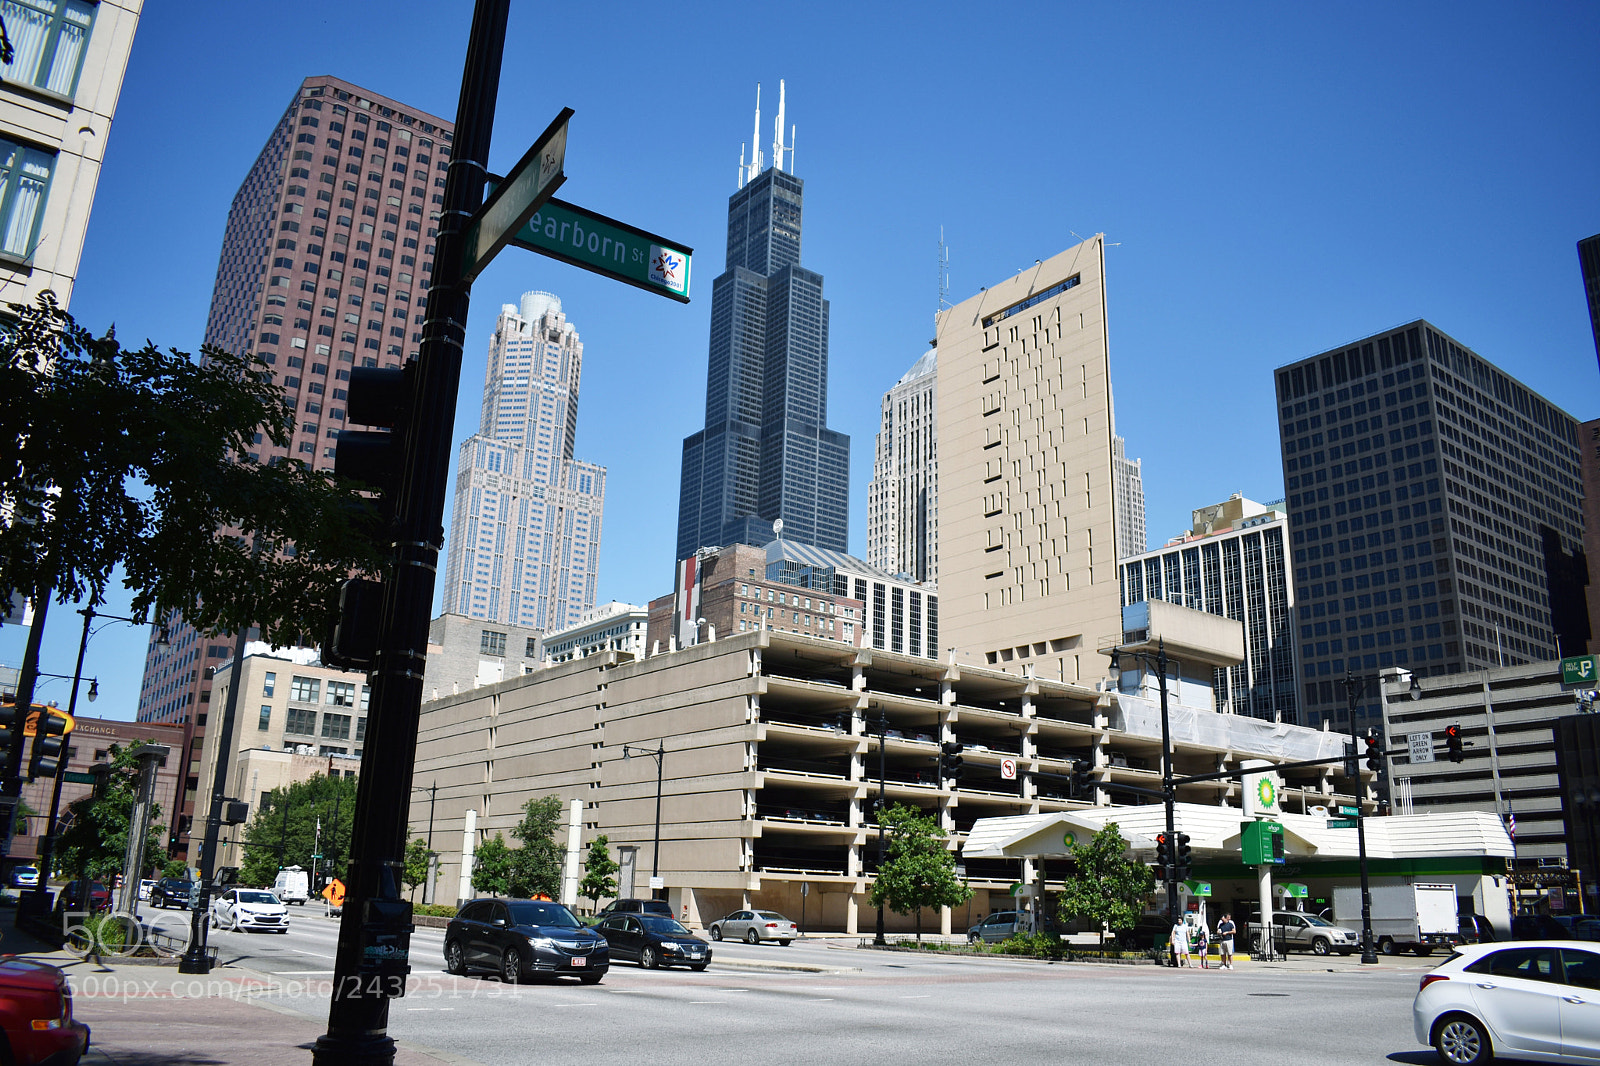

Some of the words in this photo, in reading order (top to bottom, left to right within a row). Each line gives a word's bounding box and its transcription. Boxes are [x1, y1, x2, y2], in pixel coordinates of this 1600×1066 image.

[529, 211, 626, 263] earborn
[631, 247, 644, 264] St
[75, 724, 117, 735] EXCHANGE
